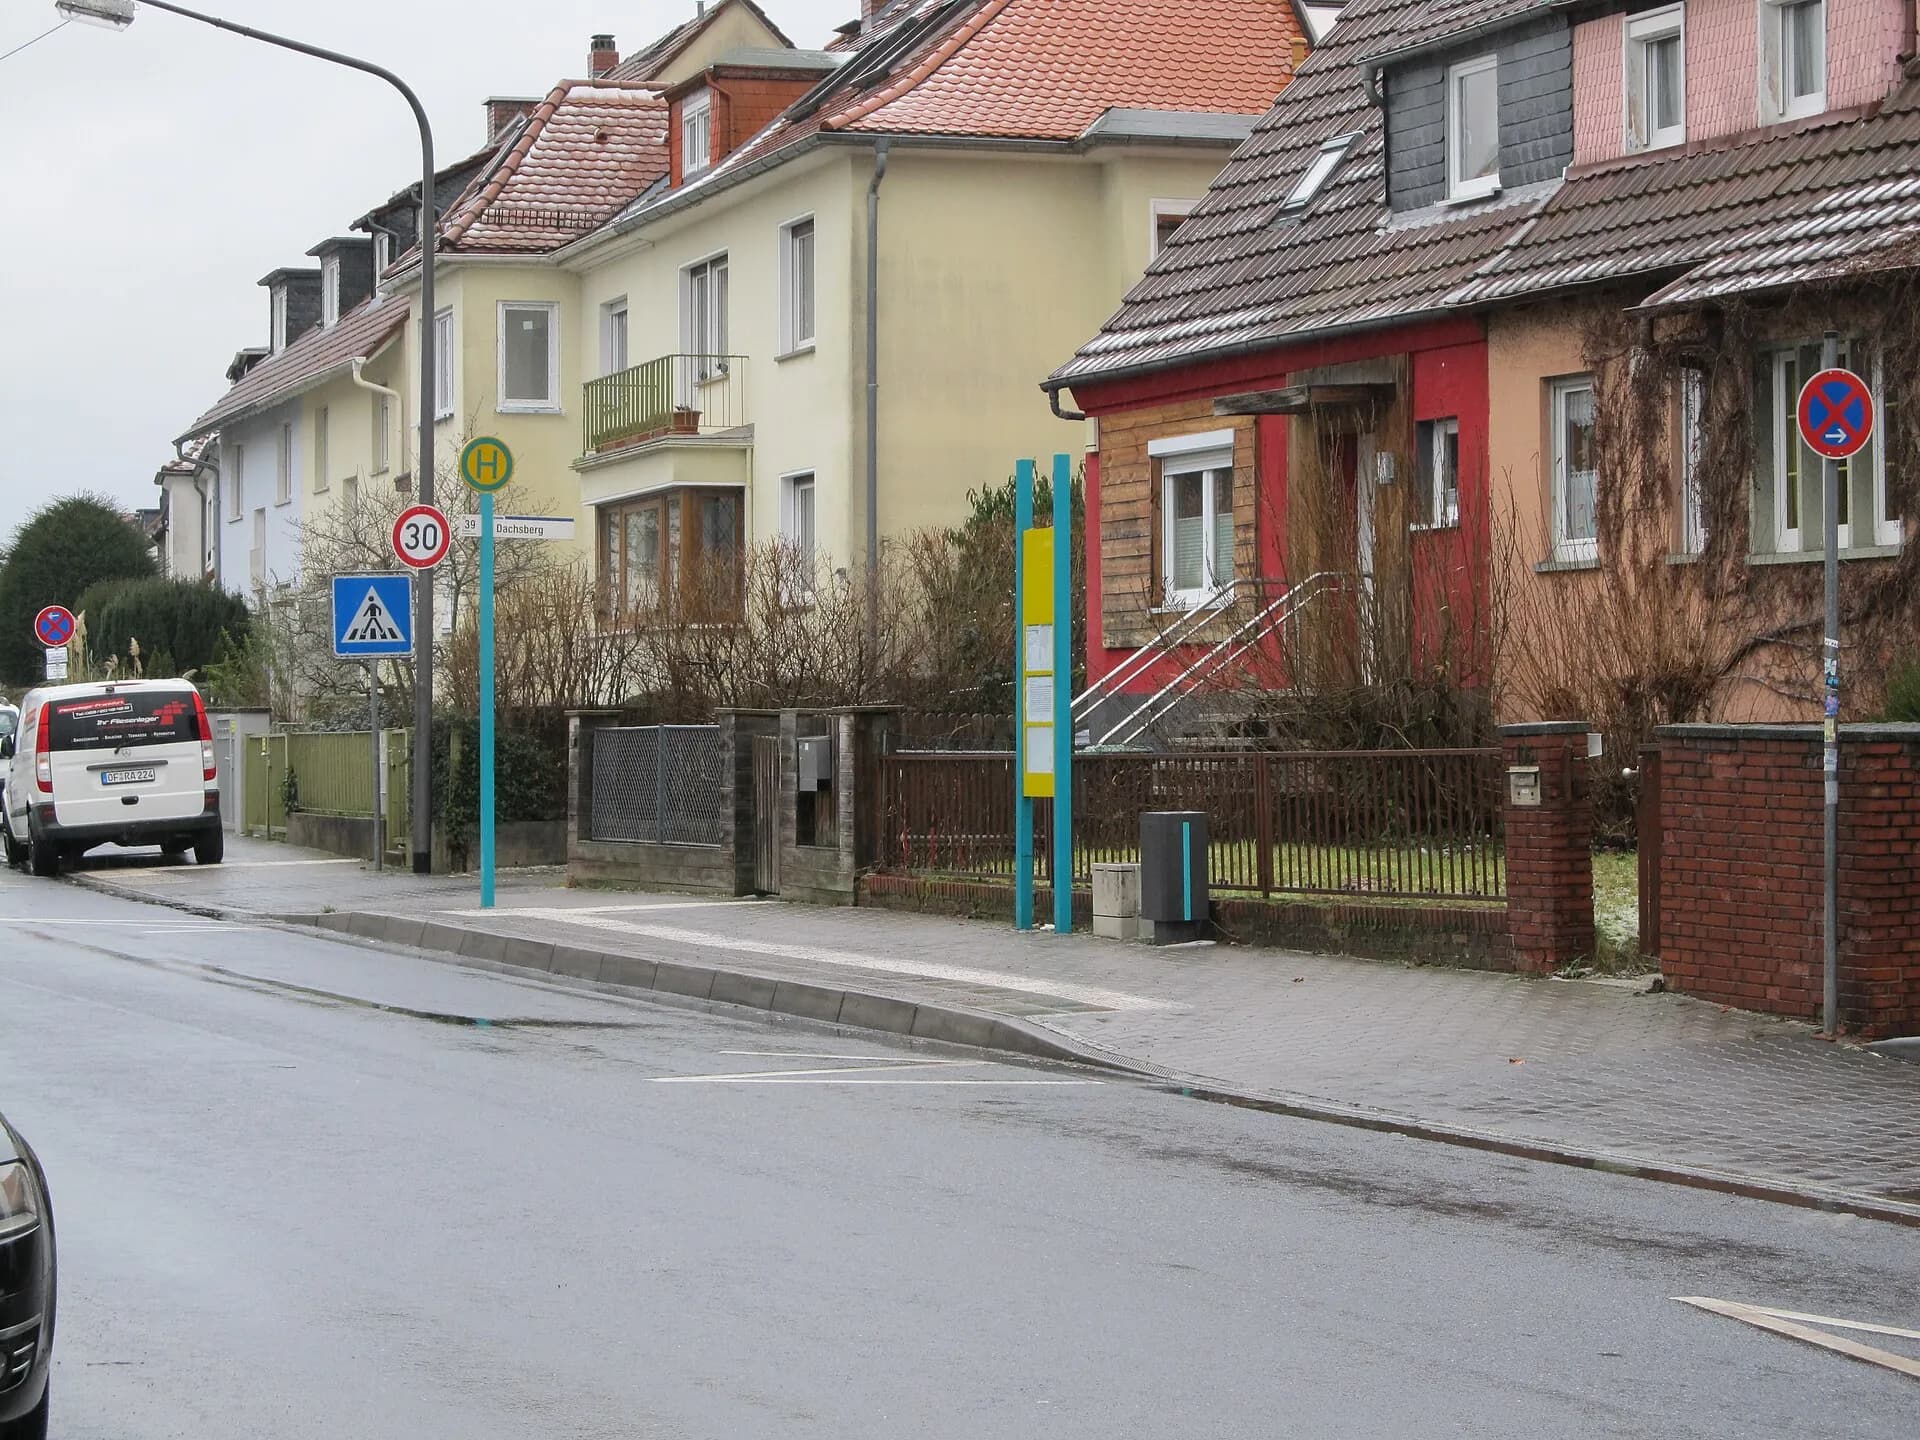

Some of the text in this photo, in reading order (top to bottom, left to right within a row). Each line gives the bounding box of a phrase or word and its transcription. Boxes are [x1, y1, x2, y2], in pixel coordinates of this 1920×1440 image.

[476, 449, 498, 479] H
[464, 519, 476, 529] 39
[496, 523, 544, 536] Dachsberg
[404, 523, 438, 551] 30
